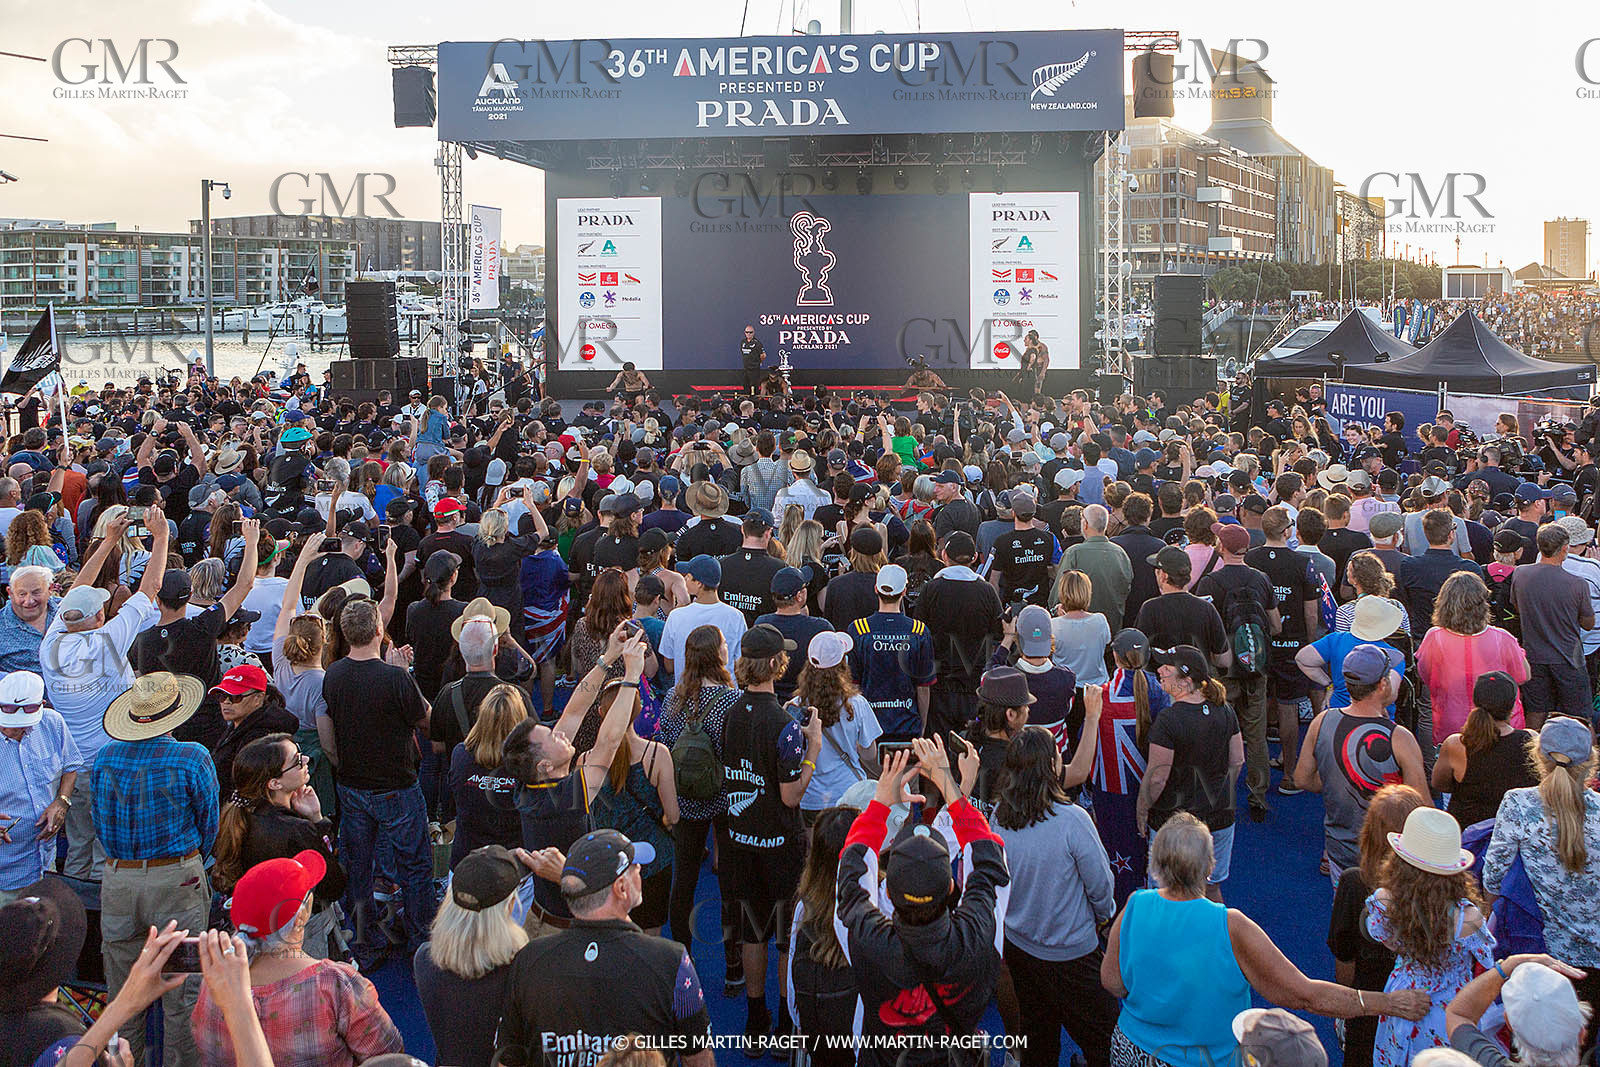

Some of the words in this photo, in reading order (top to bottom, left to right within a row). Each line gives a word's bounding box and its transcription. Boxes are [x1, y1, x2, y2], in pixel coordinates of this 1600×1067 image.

[608, 49, 667, 78] 36TH
[673, 45, 859, 77] AMERICA'S
[869, 43, 941, 72] CUP
[719, 81, 802, 94] PRESENTED
[808, 80, 825, 92] BY
[474, 97, 521, 105] AUCKLAND
[696, 98, 850, 127] PRADA
[578, 215, 634, 226] PRADA
[992, 210, 1051, 221] PRADA
[474, 214, 483, 233] CUP
[474, 236, 483, 286] AMERICA'S
[488, 239, 497, 280] PRADA
[589, 322, 618, 330] OMEGA
[760, 314, 781, 325] 36TH
[782, 314, 843, 325] AMERICA'S
[846, 313, 870, 324] CUP
[779, 330, 851, 345] PRADA
[1331, 393, 1356, 416] ARE
[1359, 395, 1386, 420] YOU
[1015, 554, 1044, 564] Emirates
[723, 591, 763, 605] Emirates
[873, 640, 911, 652] OTAGO
[1271, 640, 1300, 648] ALAND
[740, 758, 753, 771] Fly
[724, 766, 766, 787] Emirates
[478, 782, 501, 791] CUP
[735, 832, 785, 848] ZEALAND
[541, 1029, 617, 1053] Emirat
